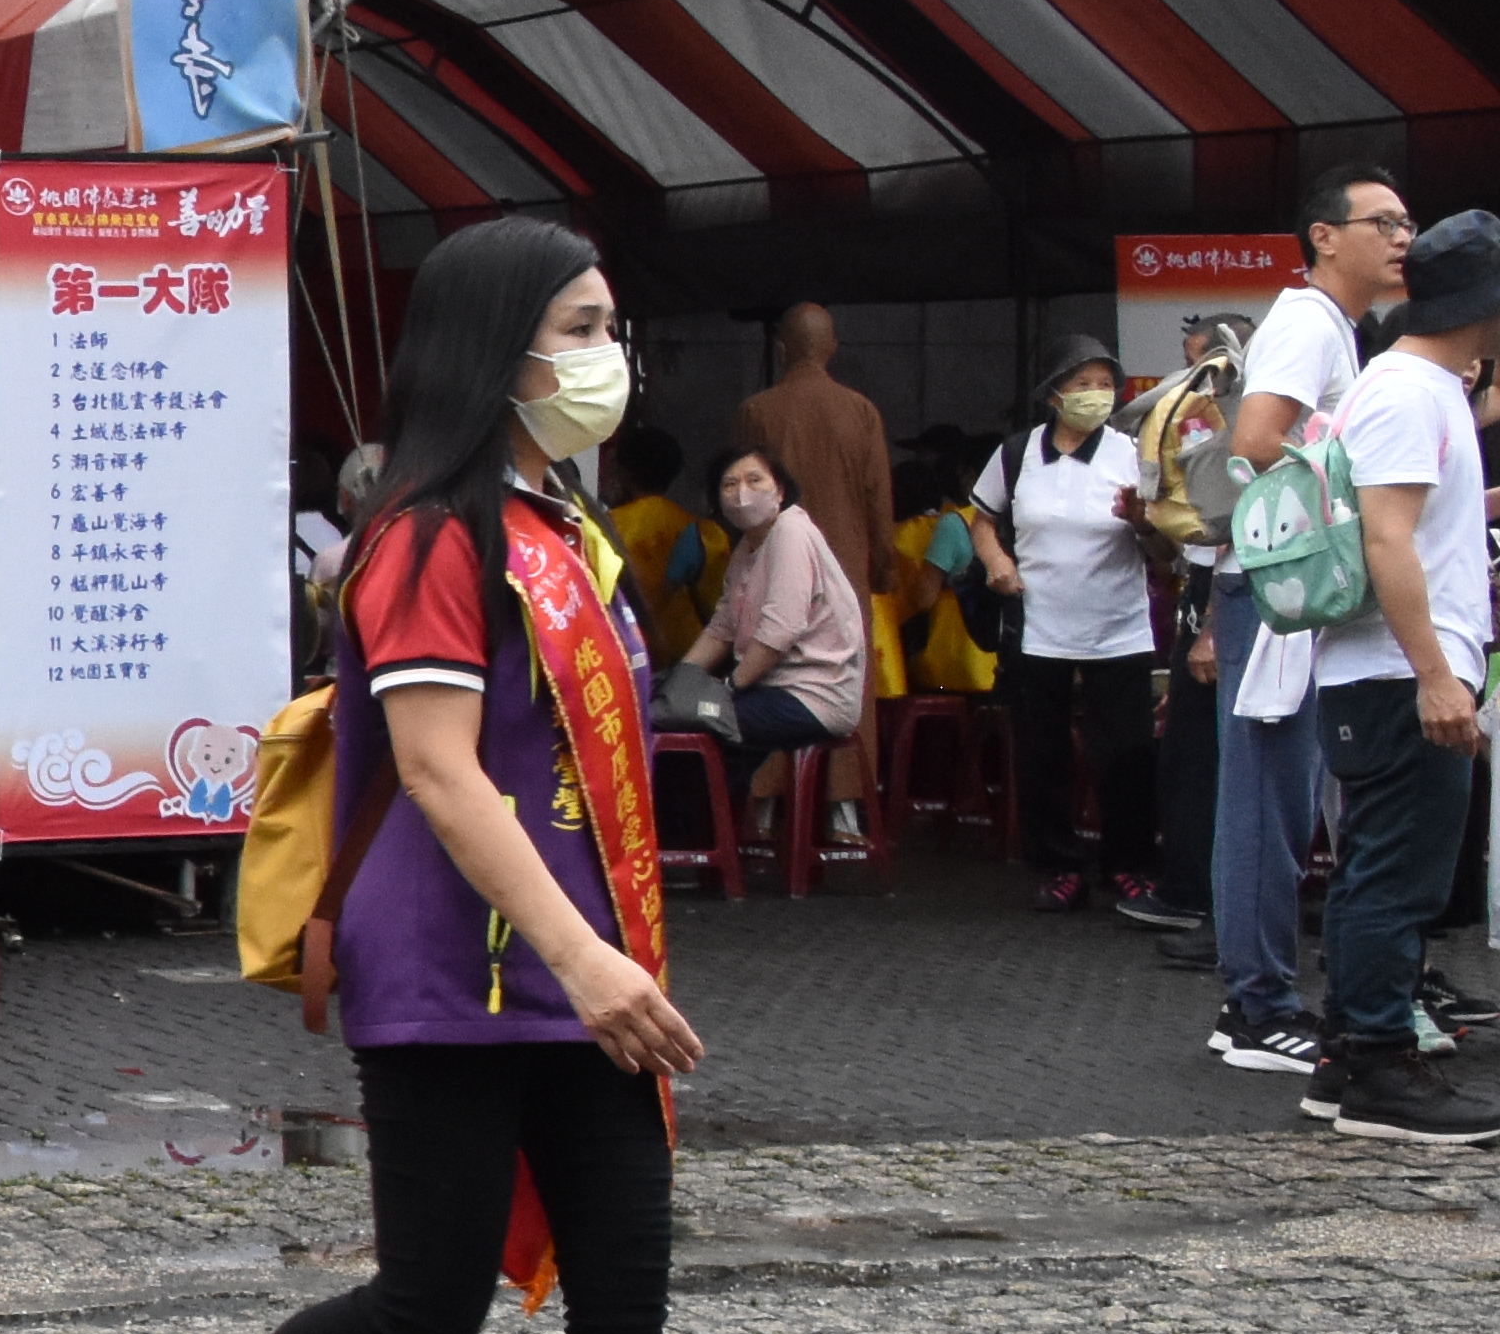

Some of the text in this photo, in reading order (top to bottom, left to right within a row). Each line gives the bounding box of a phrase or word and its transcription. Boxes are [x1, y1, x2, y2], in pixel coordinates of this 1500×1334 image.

[167, 186, 270, 238] 善的力量
[51, 266, 231, 316] 第一大隊
[52, 330, 108, 350] 1 法師
[50, 362, 61, 378] 2
[52, 393, 61, 409] 3
[50, 423, 60, 440] 4
[51, 453, 61, 469] 5
[51, 483, 61, 499] 6
[51, 514, 61, 530] 7
[51, 544, 61, 560] 8
[51, 575, 61, 591] 9
[48, 605, 64, 622] 10
[50, 636, 62, 652] 11
[48, 666, 64, 683] 12
